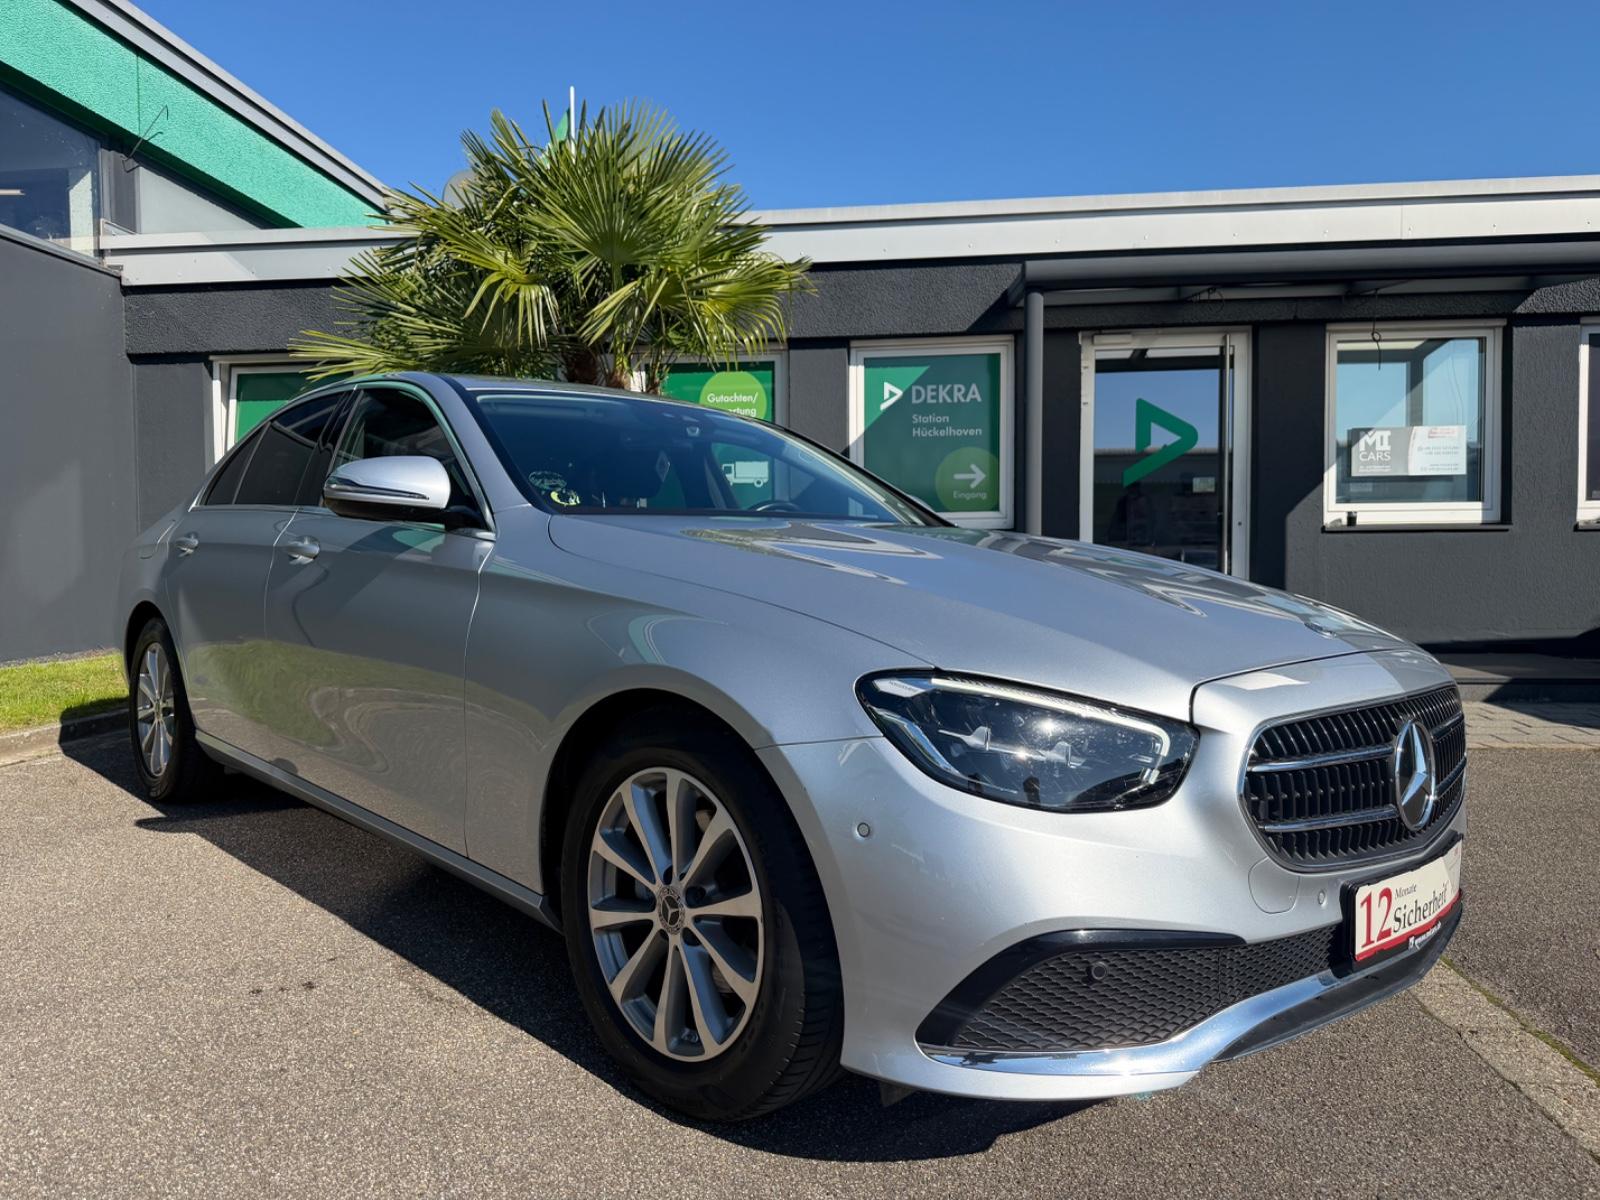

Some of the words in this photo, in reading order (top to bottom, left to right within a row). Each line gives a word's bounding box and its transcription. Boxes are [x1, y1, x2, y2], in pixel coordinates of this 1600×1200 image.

[707, 391, 759, 404] Gutachten/
[911, 383, 982, 404] DEKRA
[912, 413, 949, 424] Station
[912, 426, 982, 437] Hückelhoven
[1360, 430, 1392, 451] MI
[1359, 450, 1392, 462] CARS
[953, 490, 988, 500] Eingang
[1395, 883, 1417, 900] Monate
[1393, 879, 1449, 933] Sicherheit
[1360, 887, 1392, 948] 12
